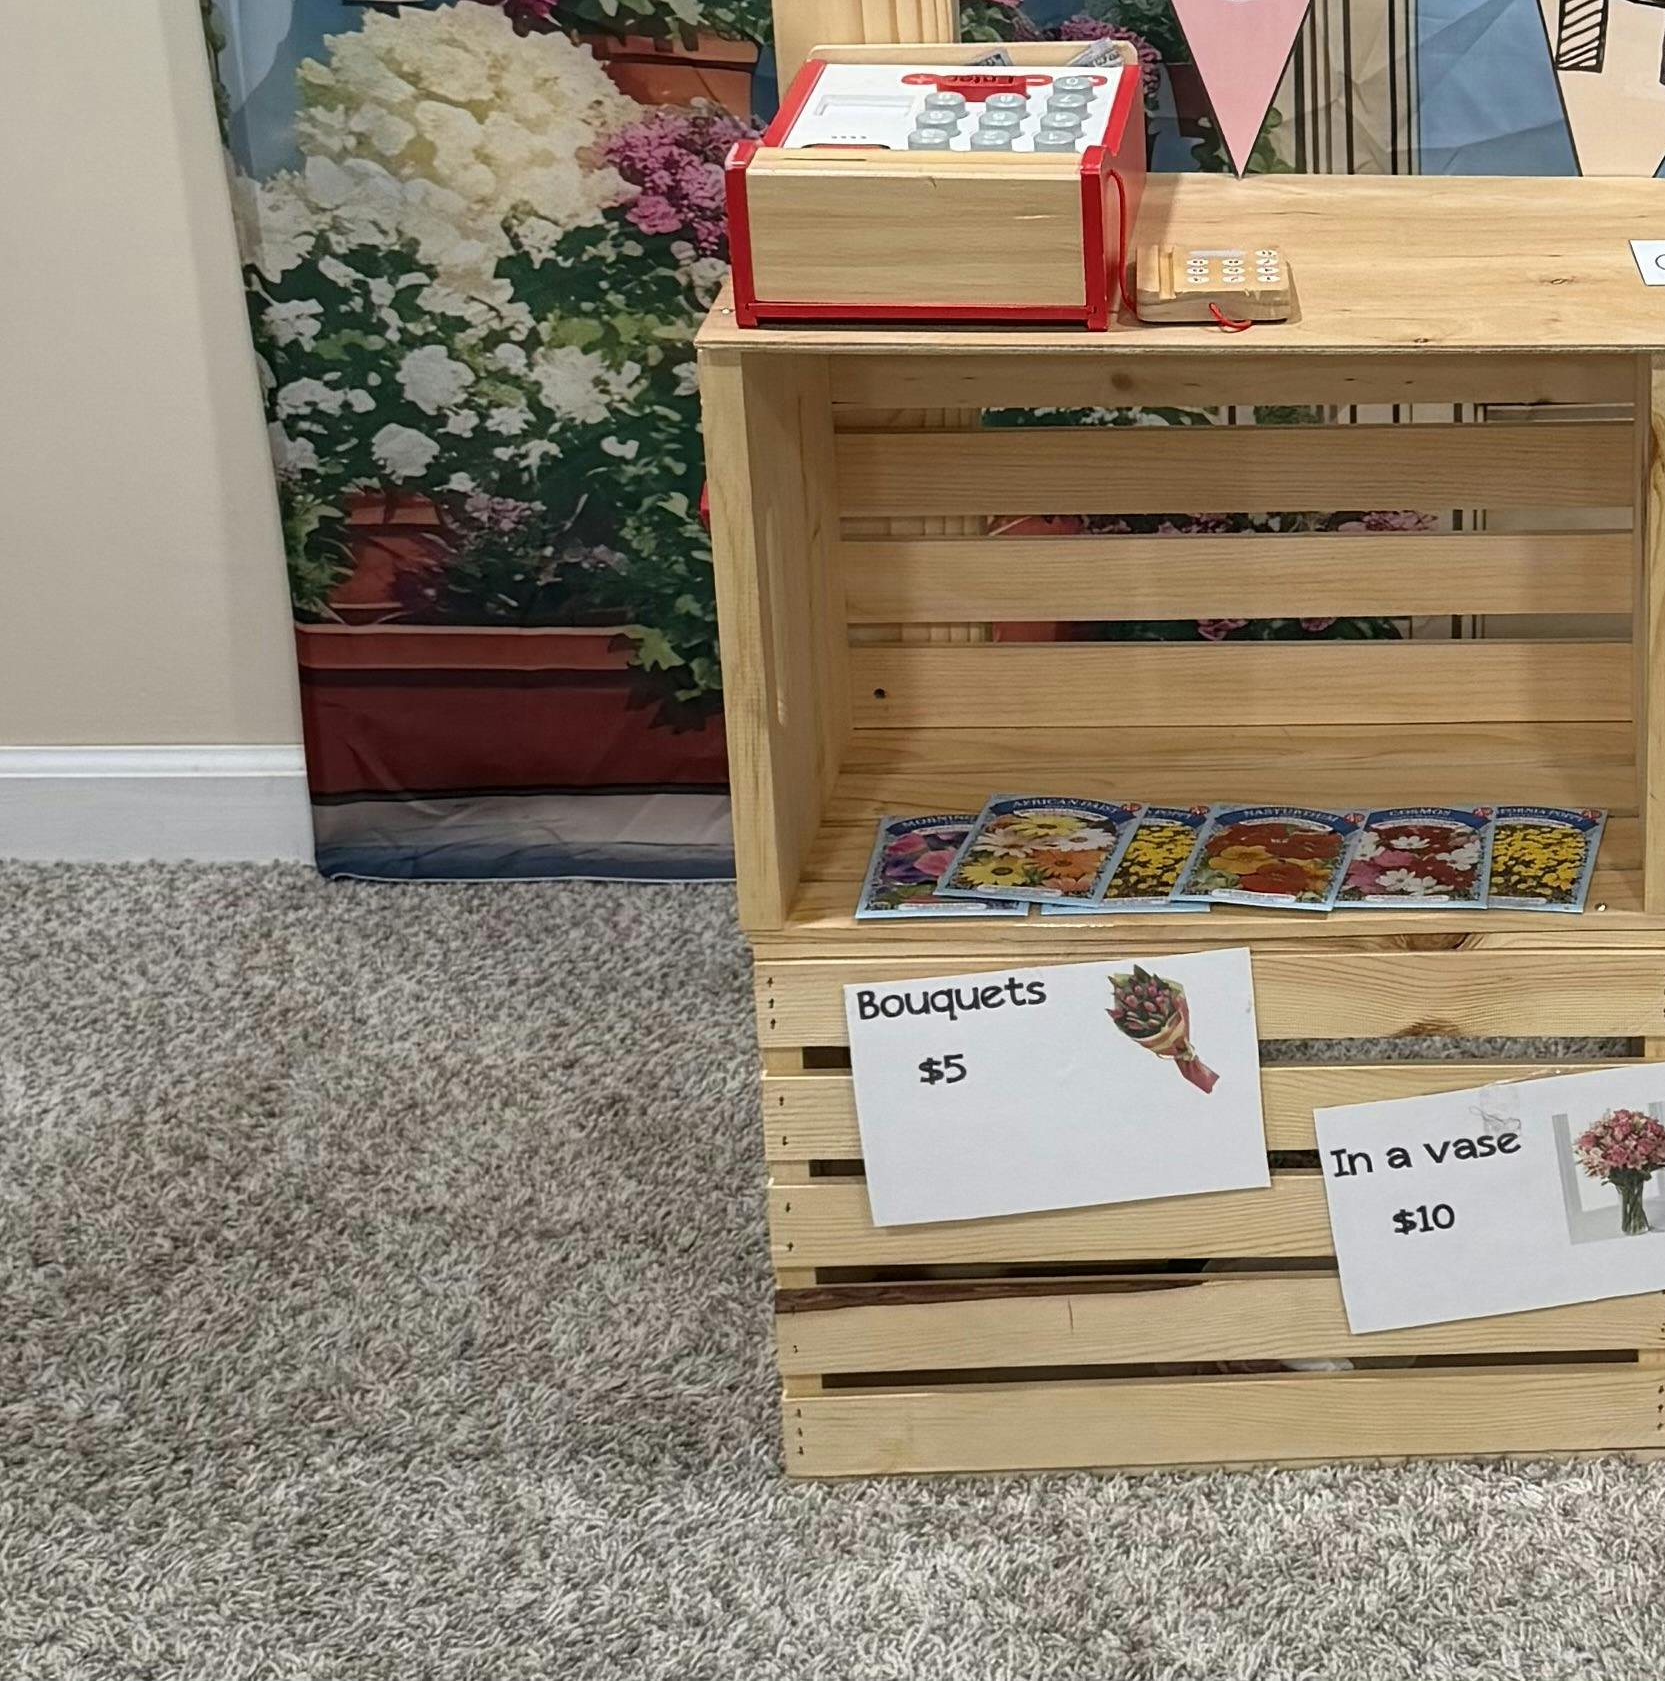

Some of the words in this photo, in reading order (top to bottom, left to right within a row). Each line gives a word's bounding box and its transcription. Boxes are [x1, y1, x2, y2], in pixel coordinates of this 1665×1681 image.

[856, 976, 1047, 1021] Bouquets
[918, 1053, 968, 1086] $5
[1330, 1147, 1374, 1178] In
[1387, 1145, 1413, 1170] a
[1423, 1131, 1522, 1165] vase
[1392, 1203, 1456, 1236] $10
